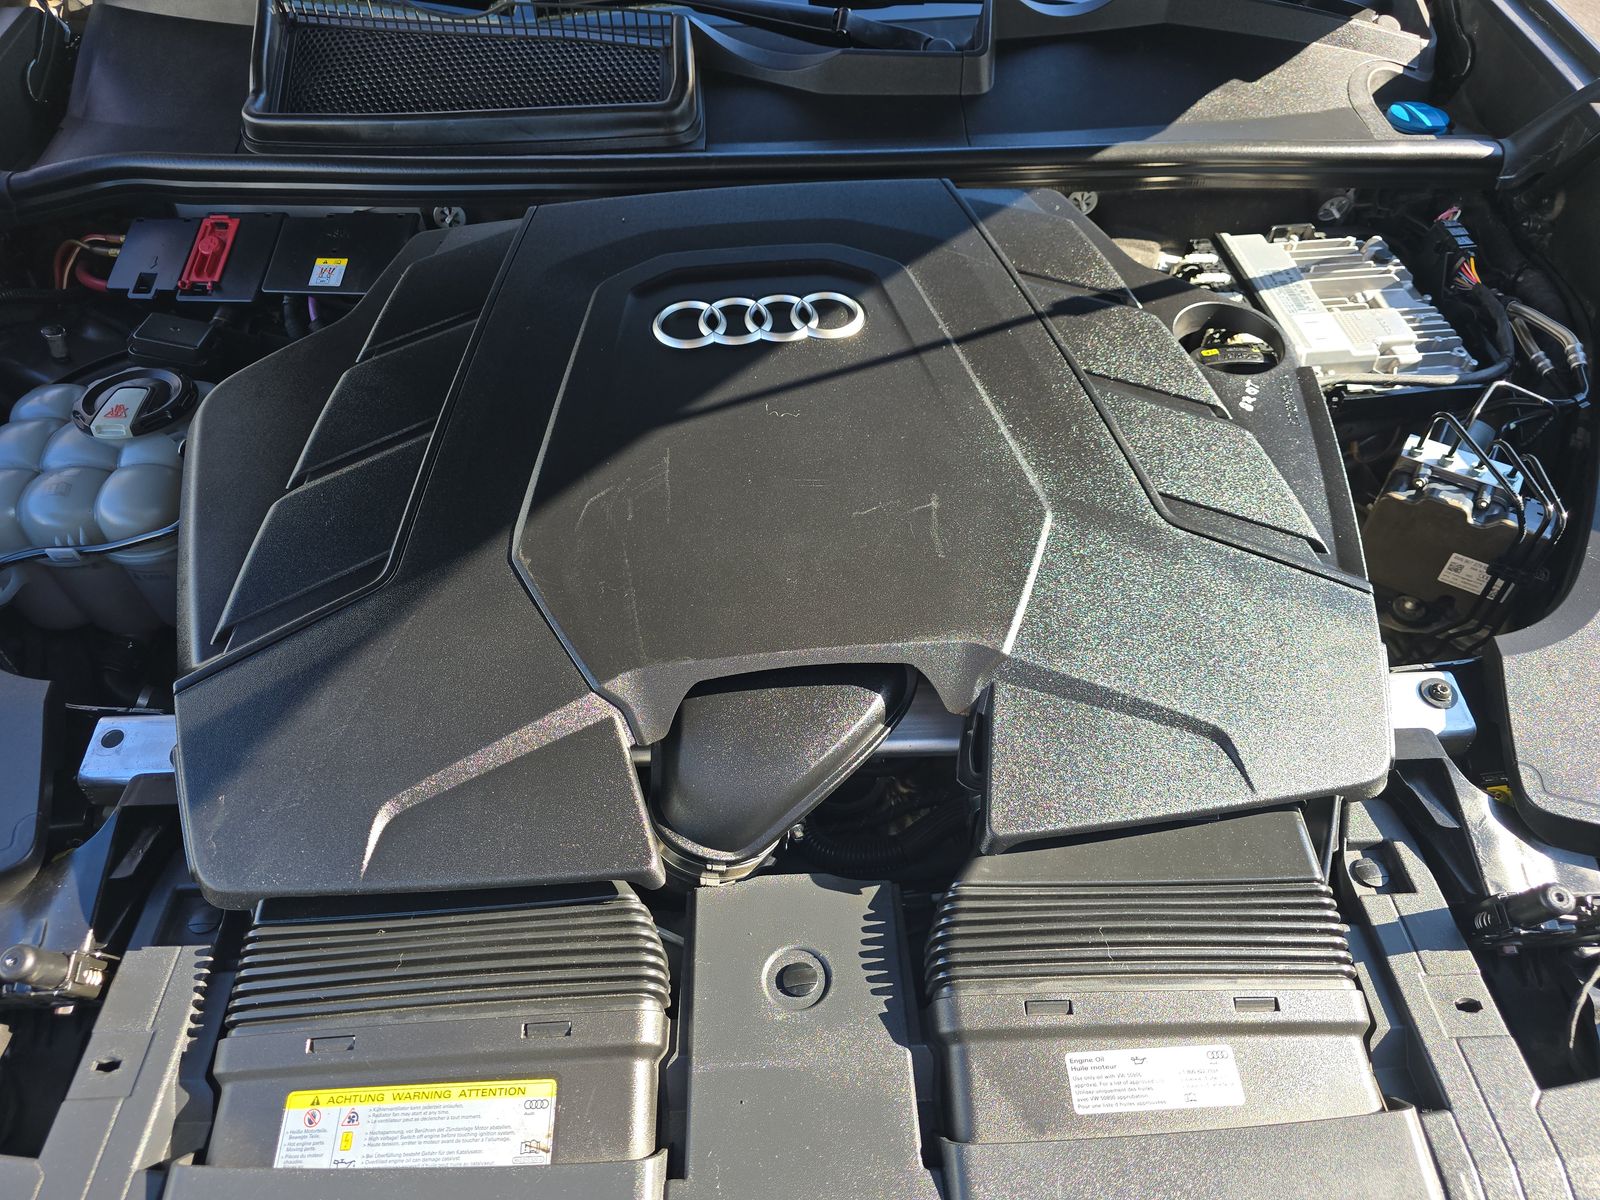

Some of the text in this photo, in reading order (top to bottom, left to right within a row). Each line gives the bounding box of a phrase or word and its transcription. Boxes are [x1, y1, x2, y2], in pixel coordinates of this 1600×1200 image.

[327, 1086, 526, 1104] ACHTUNG WARNING ATTENTION
